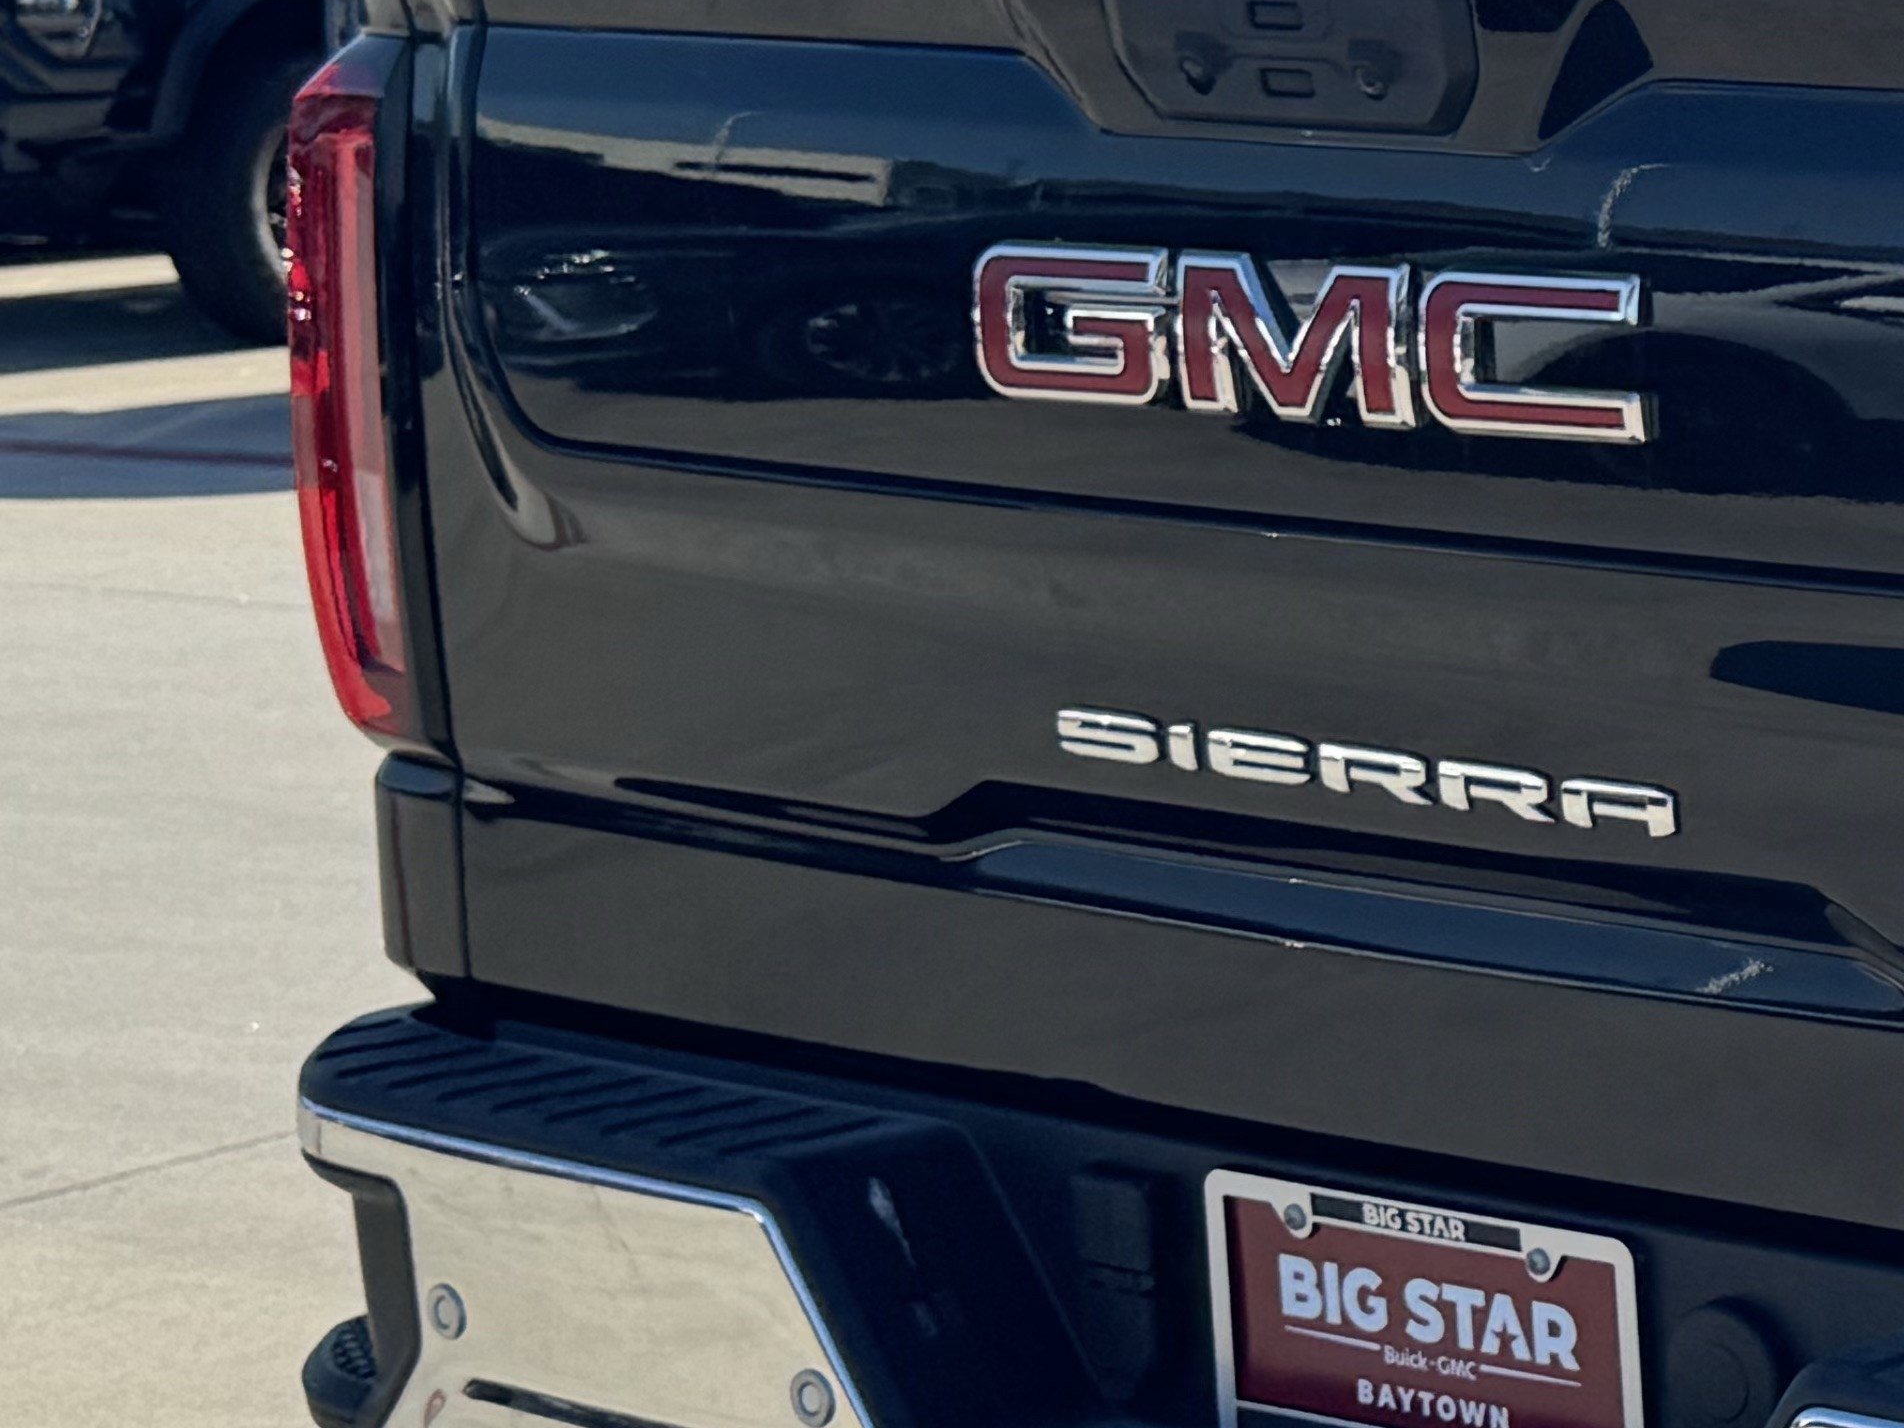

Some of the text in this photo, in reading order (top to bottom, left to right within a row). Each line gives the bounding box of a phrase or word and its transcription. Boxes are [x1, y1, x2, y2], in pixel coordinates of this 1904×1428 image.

[973, 240, 1653, 444] GMC
[1056, 704, 1680, 838] SIERRA
[1362, 1201, 1467, 1243] BIG STAR
[1277, 1253, 1581, 1372] BIG STAR
